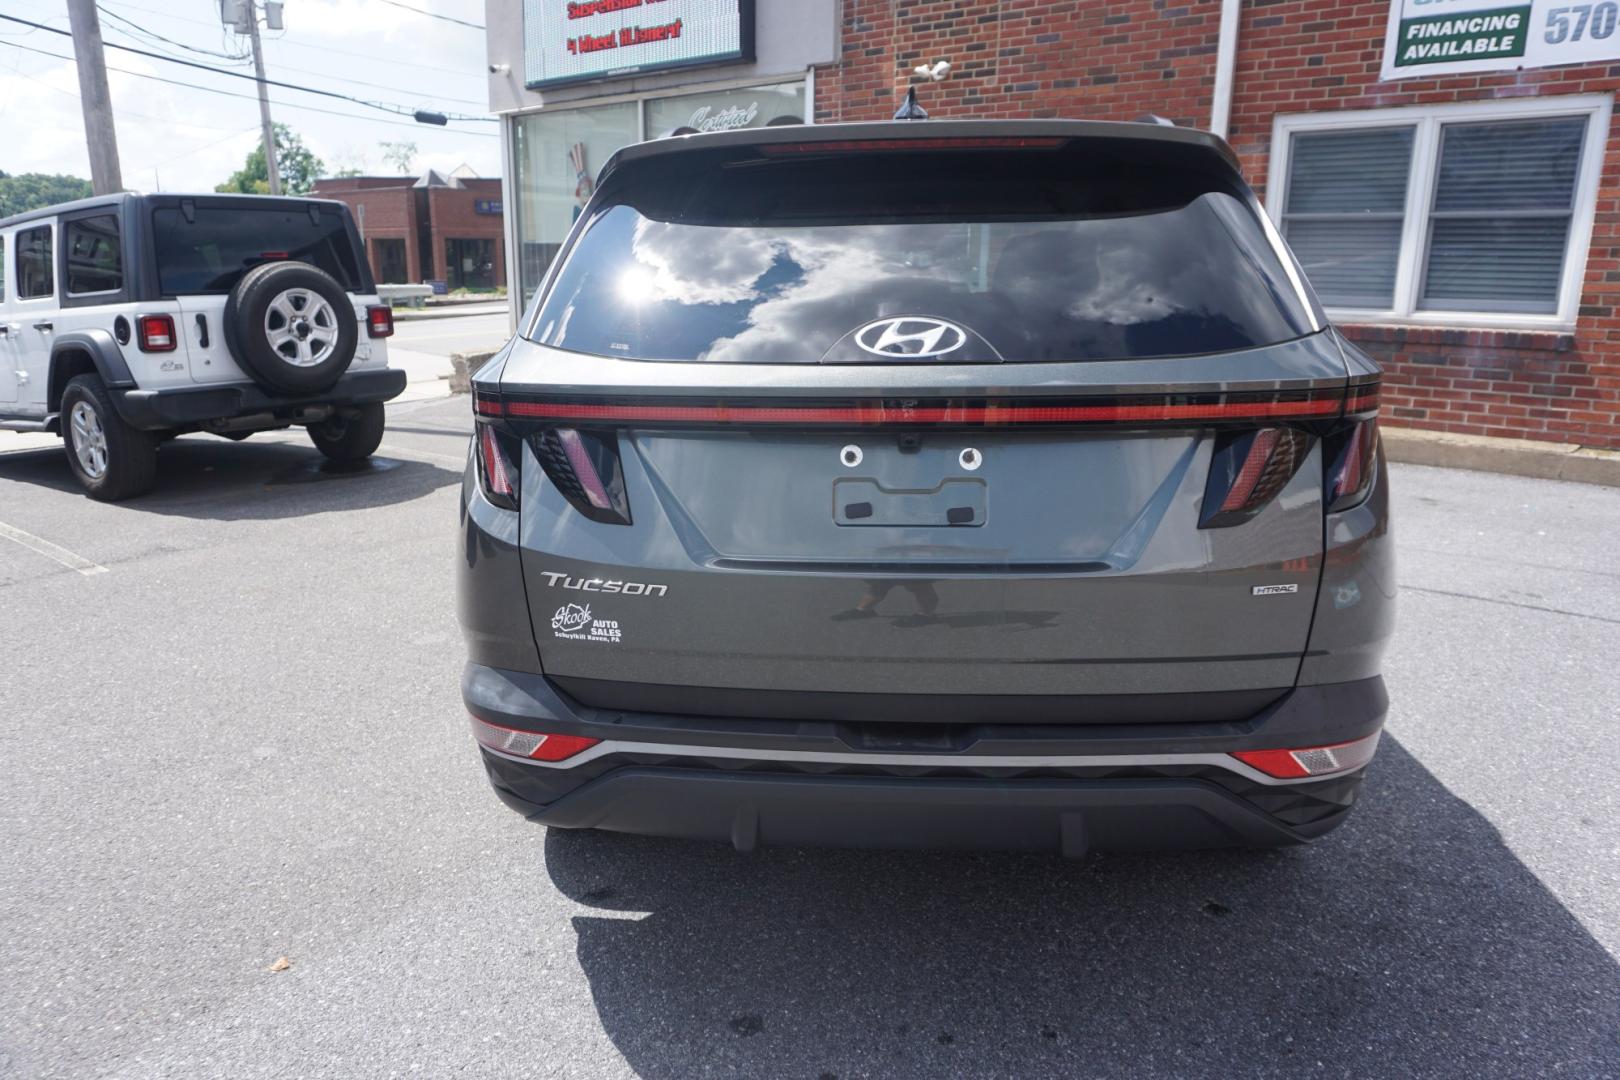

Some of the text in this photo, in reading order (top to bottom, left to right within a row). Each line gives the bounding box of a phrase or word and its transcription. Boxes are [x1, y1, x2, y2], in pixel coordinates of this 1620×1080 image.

[1407, 13, 1521, 40] FINANCING
[1544, 1, 1620, 44] 570
[567, 38, 577, 55] 4
[578, 29, 617, 54] Wheel
[1403, 35, 1515, 60] AVAILABLE
[1257, 585, 1296, 594] HTRAC
[551, 603, 592, 628] Skook
[593, 620, 618, 629] AUTO
[554, 631, 586, 640] Schuylkill
[591, 628, 622, 637] SALES
